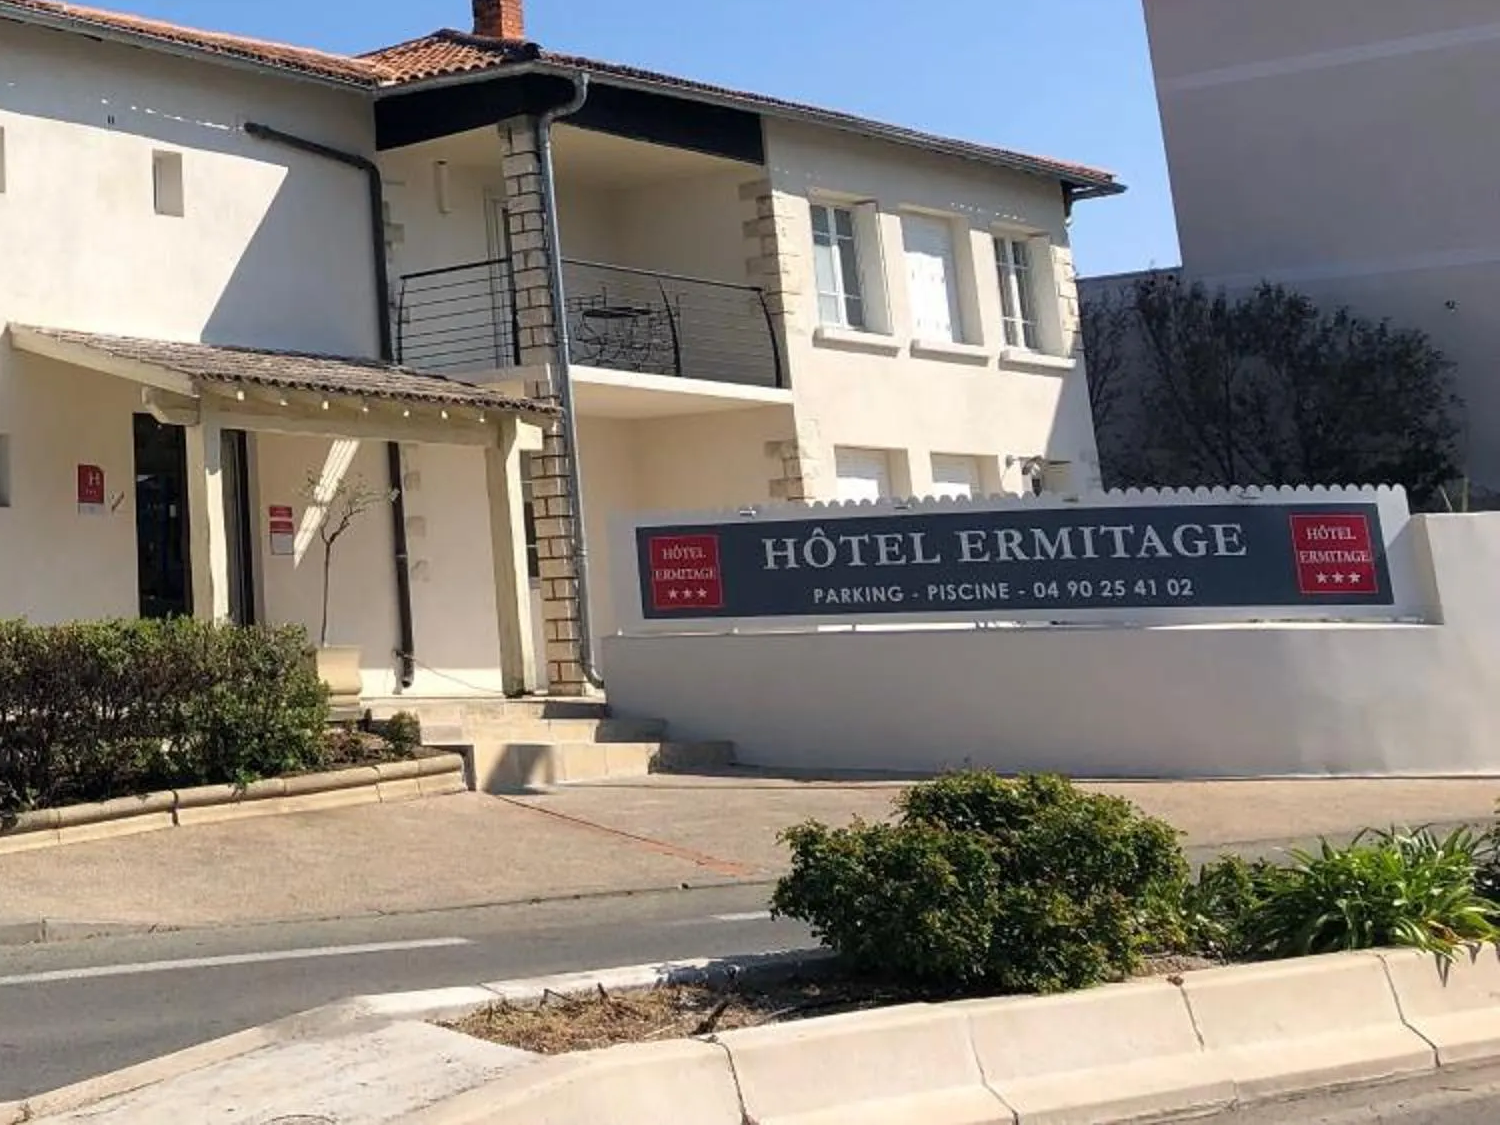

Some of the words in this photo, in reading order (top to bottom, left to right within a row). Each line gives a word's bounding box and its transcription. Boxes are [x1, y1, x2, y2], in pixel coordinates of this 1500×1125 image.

[1305, 525, 1357, 540] HÔTEL
[661, 544, 707, 560] HÔTEL
[761, 527, 941, 570] HÔTEL
[954, 524, 1247, 562] ERMITAGE
[1299, 549, 1373, 564] ERMITAGE
[813, 586, 905, 604] PARKING
[927, 582, 1011, 601] PISCINE
[1033, 581, 1060, 599] 04
[1067, 580, 1093, 598] 90
[1100, 579, 1126, 597] 25
[1134, 579, 1157, 596] 41
[1166, 578, 1194, 597] 02
